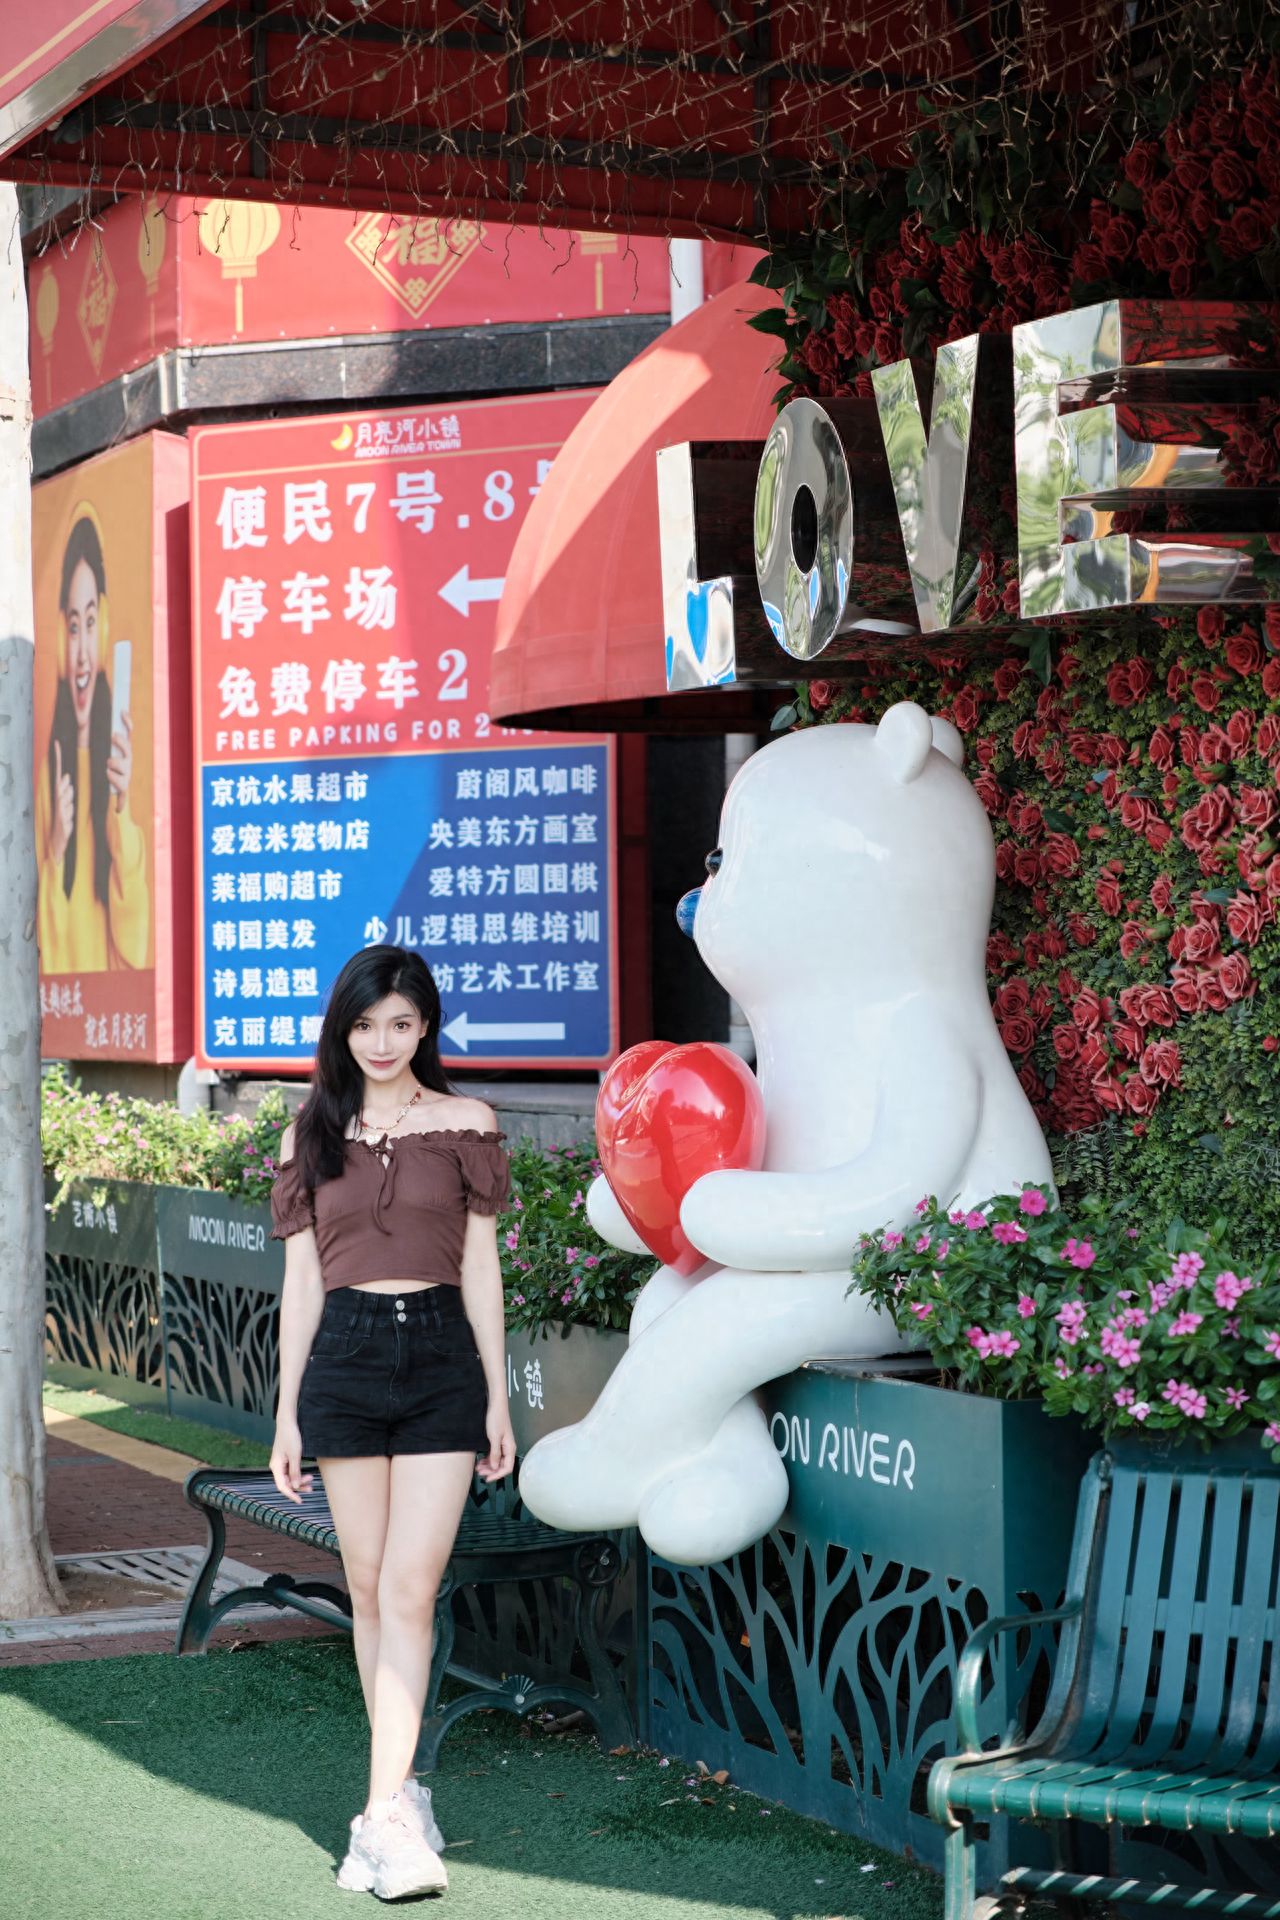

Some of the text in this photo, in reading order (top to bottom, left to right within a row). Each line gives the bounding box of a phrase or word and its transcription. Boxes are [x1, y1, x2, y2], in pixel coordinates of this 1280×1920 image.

[354, 438, 461, 458] MOON RIVER TOWN
[655, 299, 1131, 692] LOVE
[215, 565, 398, 640] 停车场
[216, 728, 276, 751] FREE
[411, 719, 461, 741] FOR
[475, 712, 490, 738] 2
[210, 770, 369, 807] 京杭水果超市
[211, 818, 370, 855] 爱宠米宠物店
[428, 812, 598, 850] 央美东方画室
[428, 862, 598, 898] 爱特方圆围棋
[212, 918, 316, 951] 韩国美发
[363, 910, 600, 948] 少儿逻辑思维培训
[212, 967, 319, 998] 诗易造型
[188, 1214, 265, 1252] MOON RIVER
[770, 1411, 916, 1490] ON RIVER
